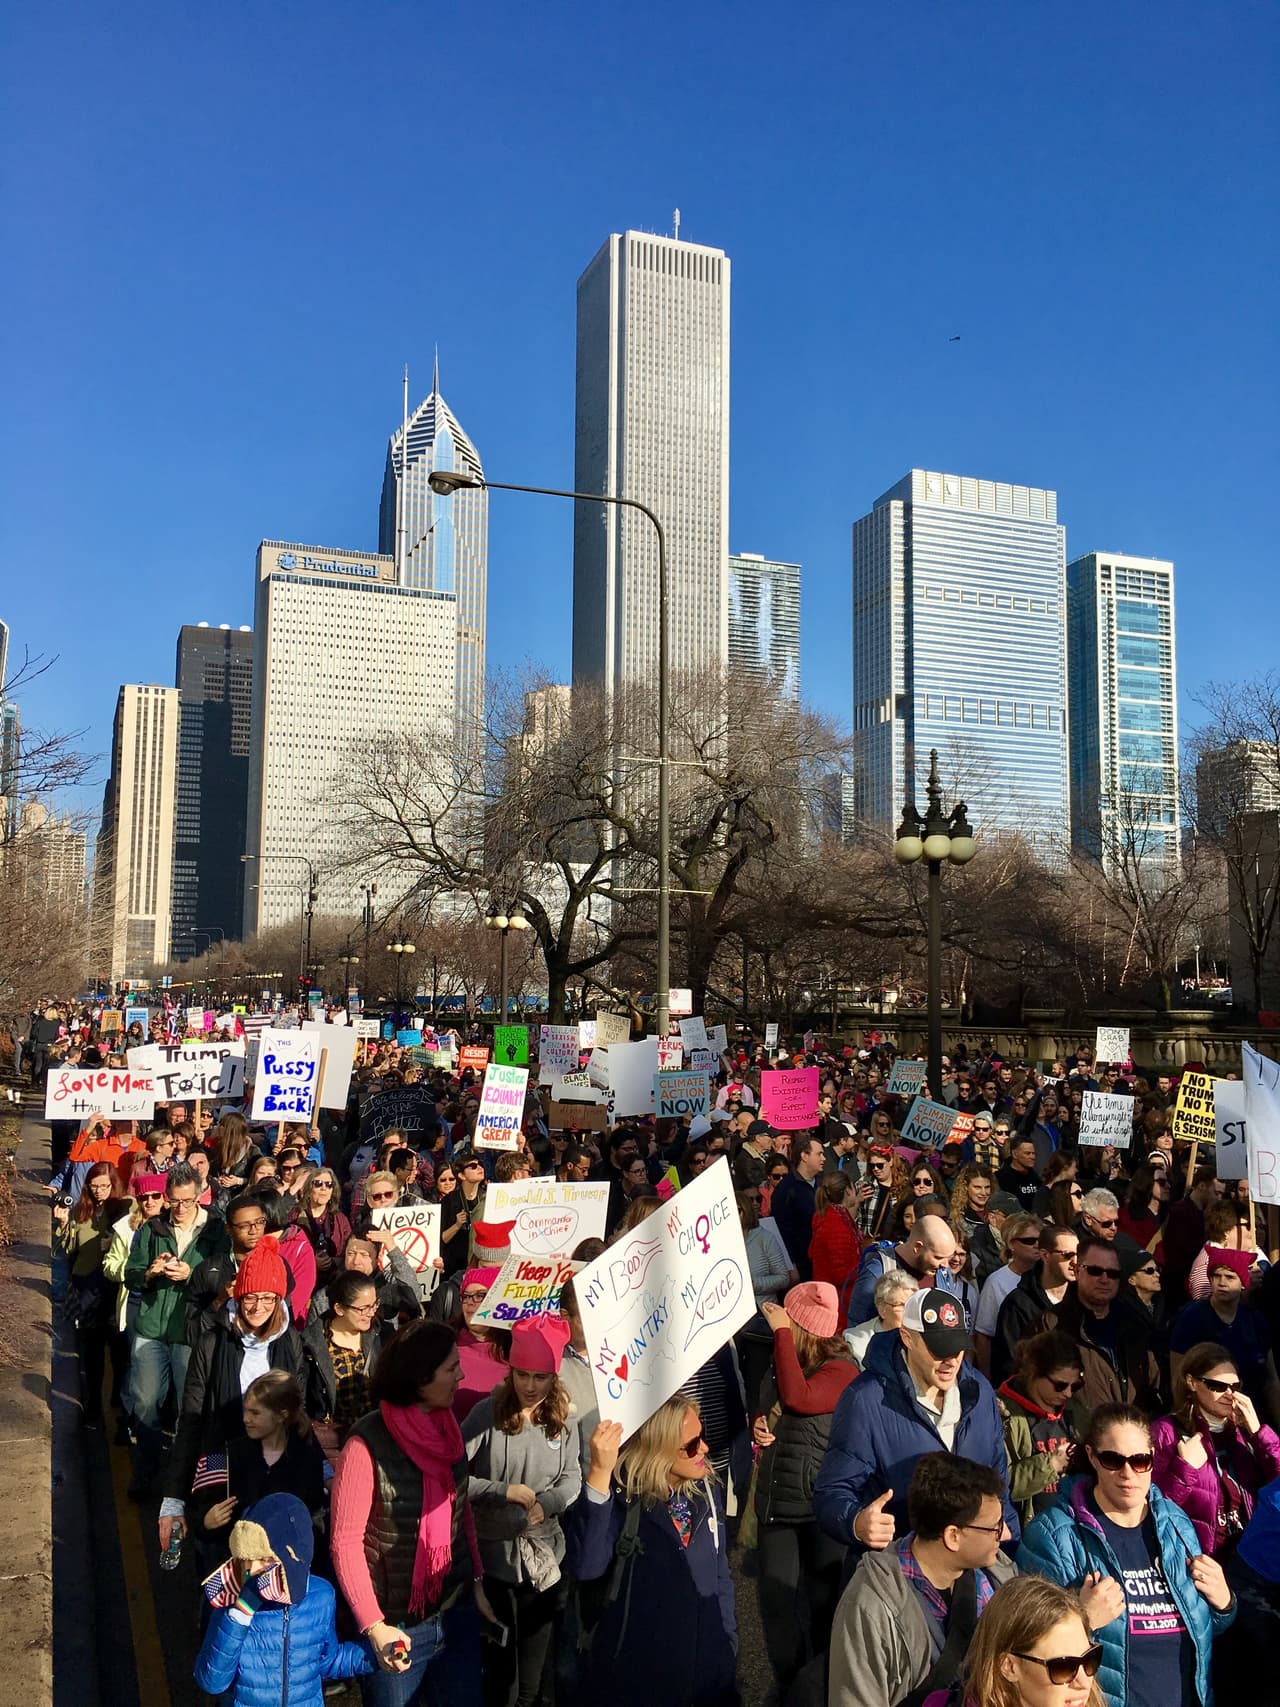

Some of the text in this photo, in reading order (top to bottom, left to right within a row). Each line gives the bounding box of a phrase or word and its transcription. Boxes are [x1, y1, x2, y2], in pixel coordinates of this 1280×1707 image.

[303, 556, 379, 578] Prudential
[602, 1021, 624, 1034] TRUMP
[551, 1034, 576, 1042] SEXISM
[605, 1031, 620, 1041] NOT
[1100, 1033, 1125, 1042] GRAB
[276, 1039, 292, 1047] THIS
[656, 1041, 684, 1050] TERUS
[463, 1048, 488, 1058] RESIST
[546, 1049, 574, 1057] CULTURE
[896, 1065, 924, 1074] CLIMATE
[563, 1073, 589, 1084] BLACK
[659, 1076, 705, 1089] CLIMATE
[894, 1073, 922, 1081] ACTION
[1188, 1073, 1216, 1090] NO T
[891, 1080, 920, 1093] NOW
[1181, 1084, 1214, 1101] TRUM
[660, 1087, 705, 1100] ACTION
[660, 1098, 706, 1116] NOW
[1183, 1097, 1202, 1110] NO
[917, 1104, 954, 1124] CLIMATE
[912, 1113, 949, 1134] ACTION
[952, 1115, 974, 1131] SIS
[1079, 1121, 1090, 1134] do
[1092, 1122, 1113, 1135] what
[481, 1127, 513, 1141] GREAT
[906, 1122, 947, 1147] NOW
[1174, 1121, 1216, 1141] & SEXISM
[1257, 1150, 1277, 1198] B
[379, 1210, 436, 1231] Never
[666, 1205, 683, 1239] MY
[552, 1261, 578, 1285] Yo
[584, 1270, 605, 1308] MY
[680, 1274, 697, 1309] MY
[546, 1298, 561, 1311] M
[595, 1337, 617, 1376] MY
[1123, 1566, 1158, 1579] omen's
[1142, 1618, 1178, 1630] 1.21.2017
